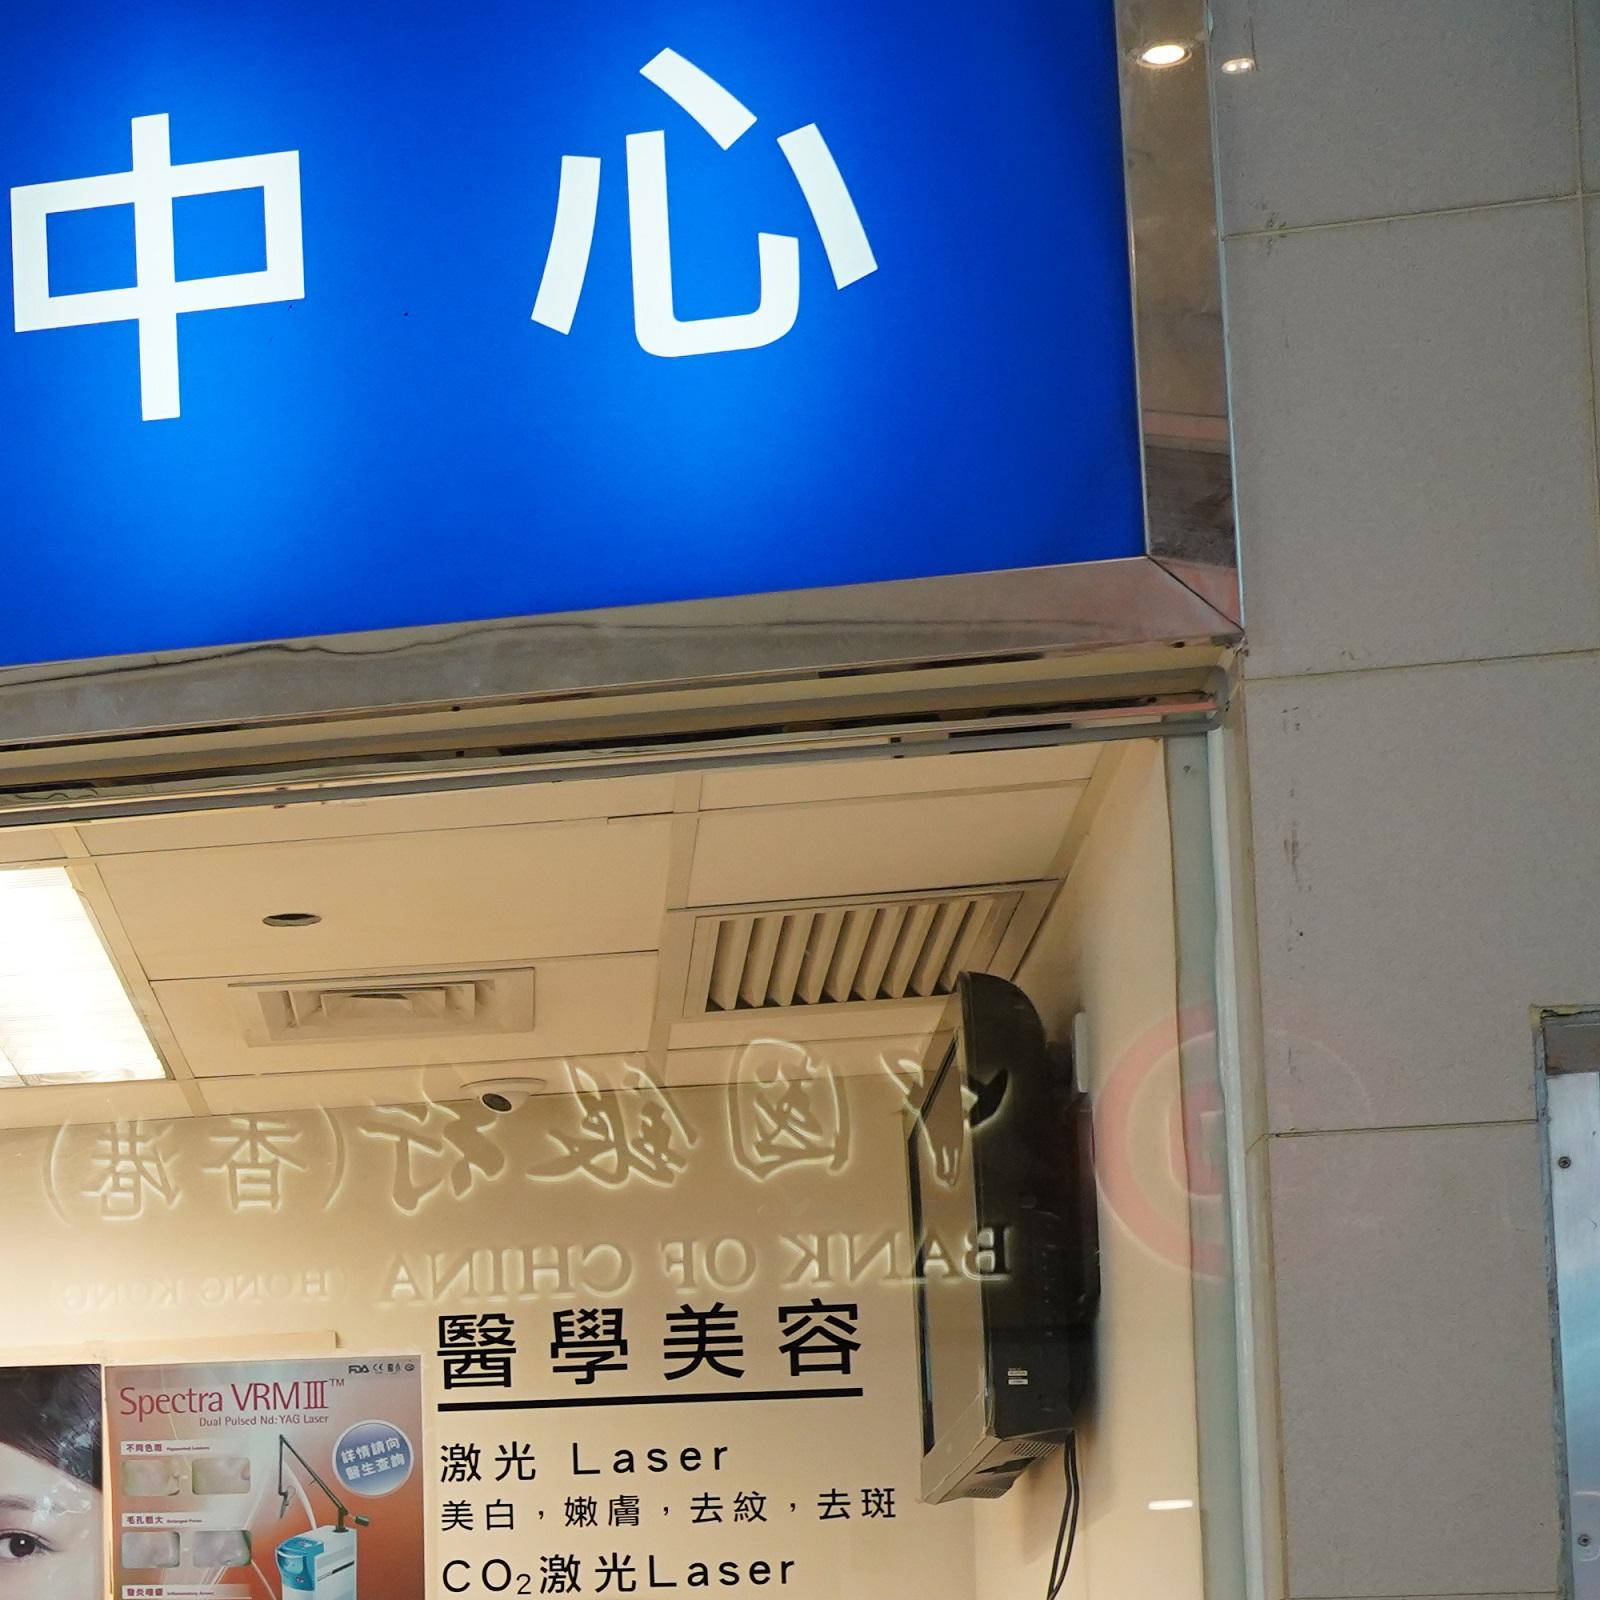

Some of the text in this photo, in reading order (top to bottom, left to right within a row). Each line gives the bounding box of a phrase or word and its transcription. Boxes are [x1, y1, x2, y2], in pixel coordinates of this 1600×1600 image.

[437, 1298, 862, 1390] 醫學美容
[348, 1365, 370, 1374] FDA
[120, 1386, 223, 1422] Spectra
[199, 1414, 329, 1427] Dual Pulsed Nd:YAG Laser
[440, 1441, 729, 1483] 激光 Laser
